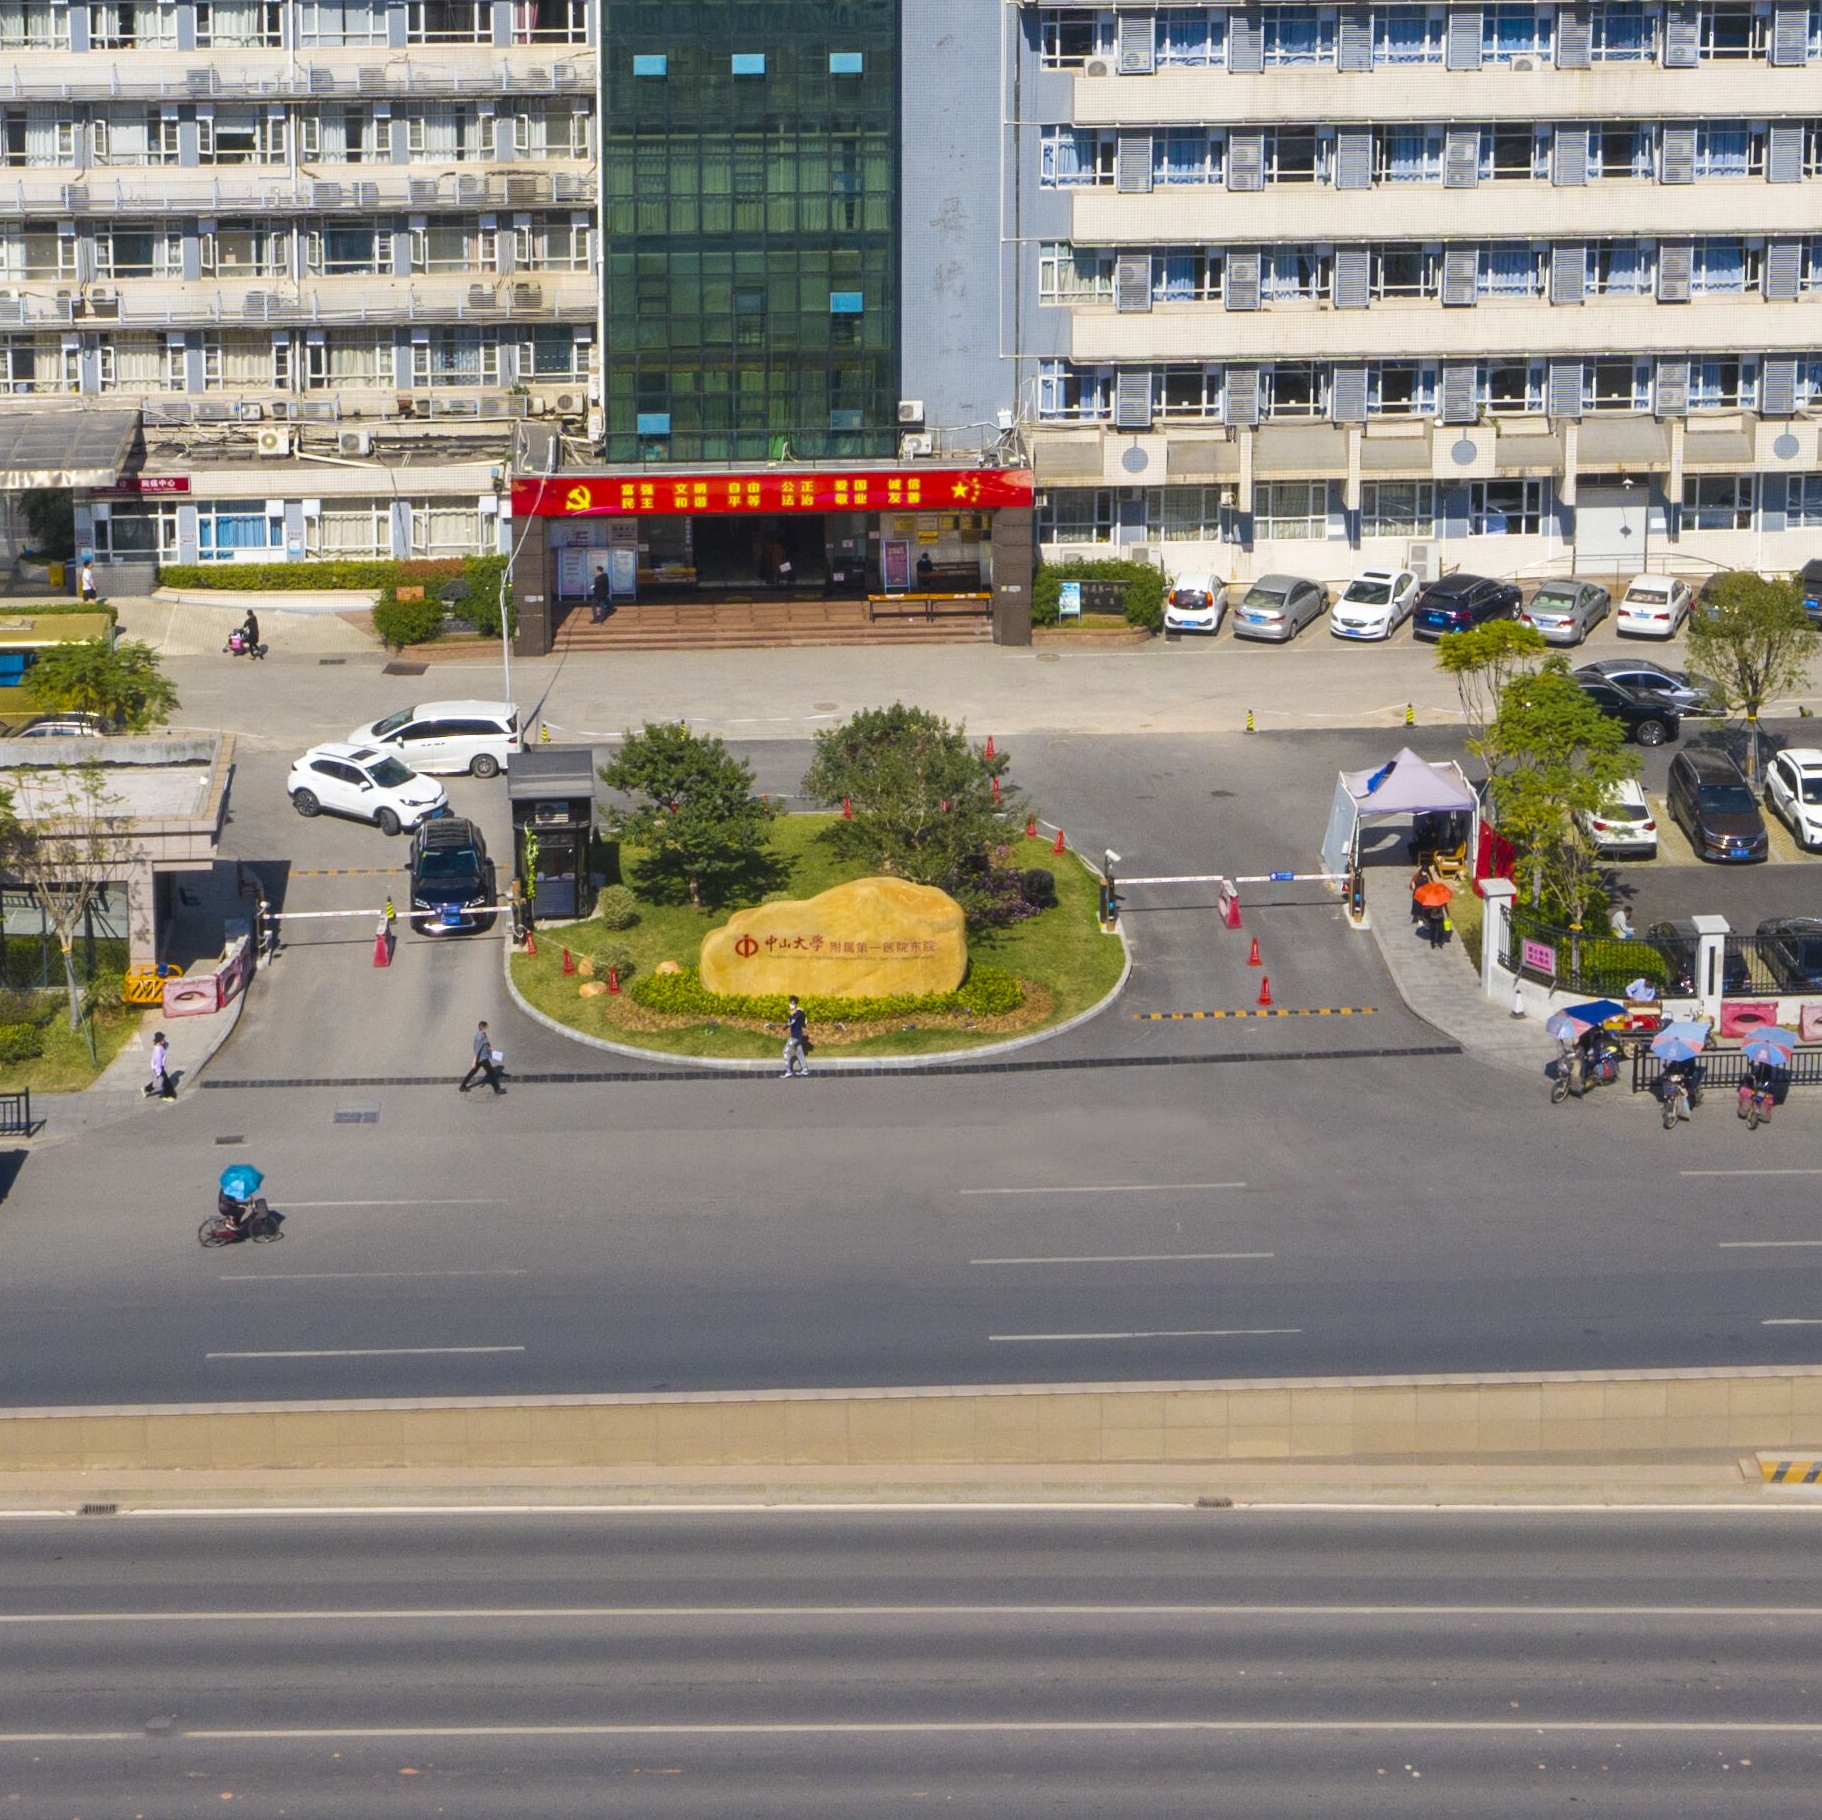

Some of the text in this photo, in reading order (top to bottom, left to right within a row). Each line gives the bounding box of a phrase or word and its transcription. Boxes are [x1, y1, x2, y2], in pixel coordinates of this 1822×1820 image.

[621, 478, 921, 496] 富强 文明 自由 公正 爱国 诚信
[621, 491, 921, 510] 民主 和谐 平等 法治 敬业 友善
[765, 934, 824, 953] 中山大學
